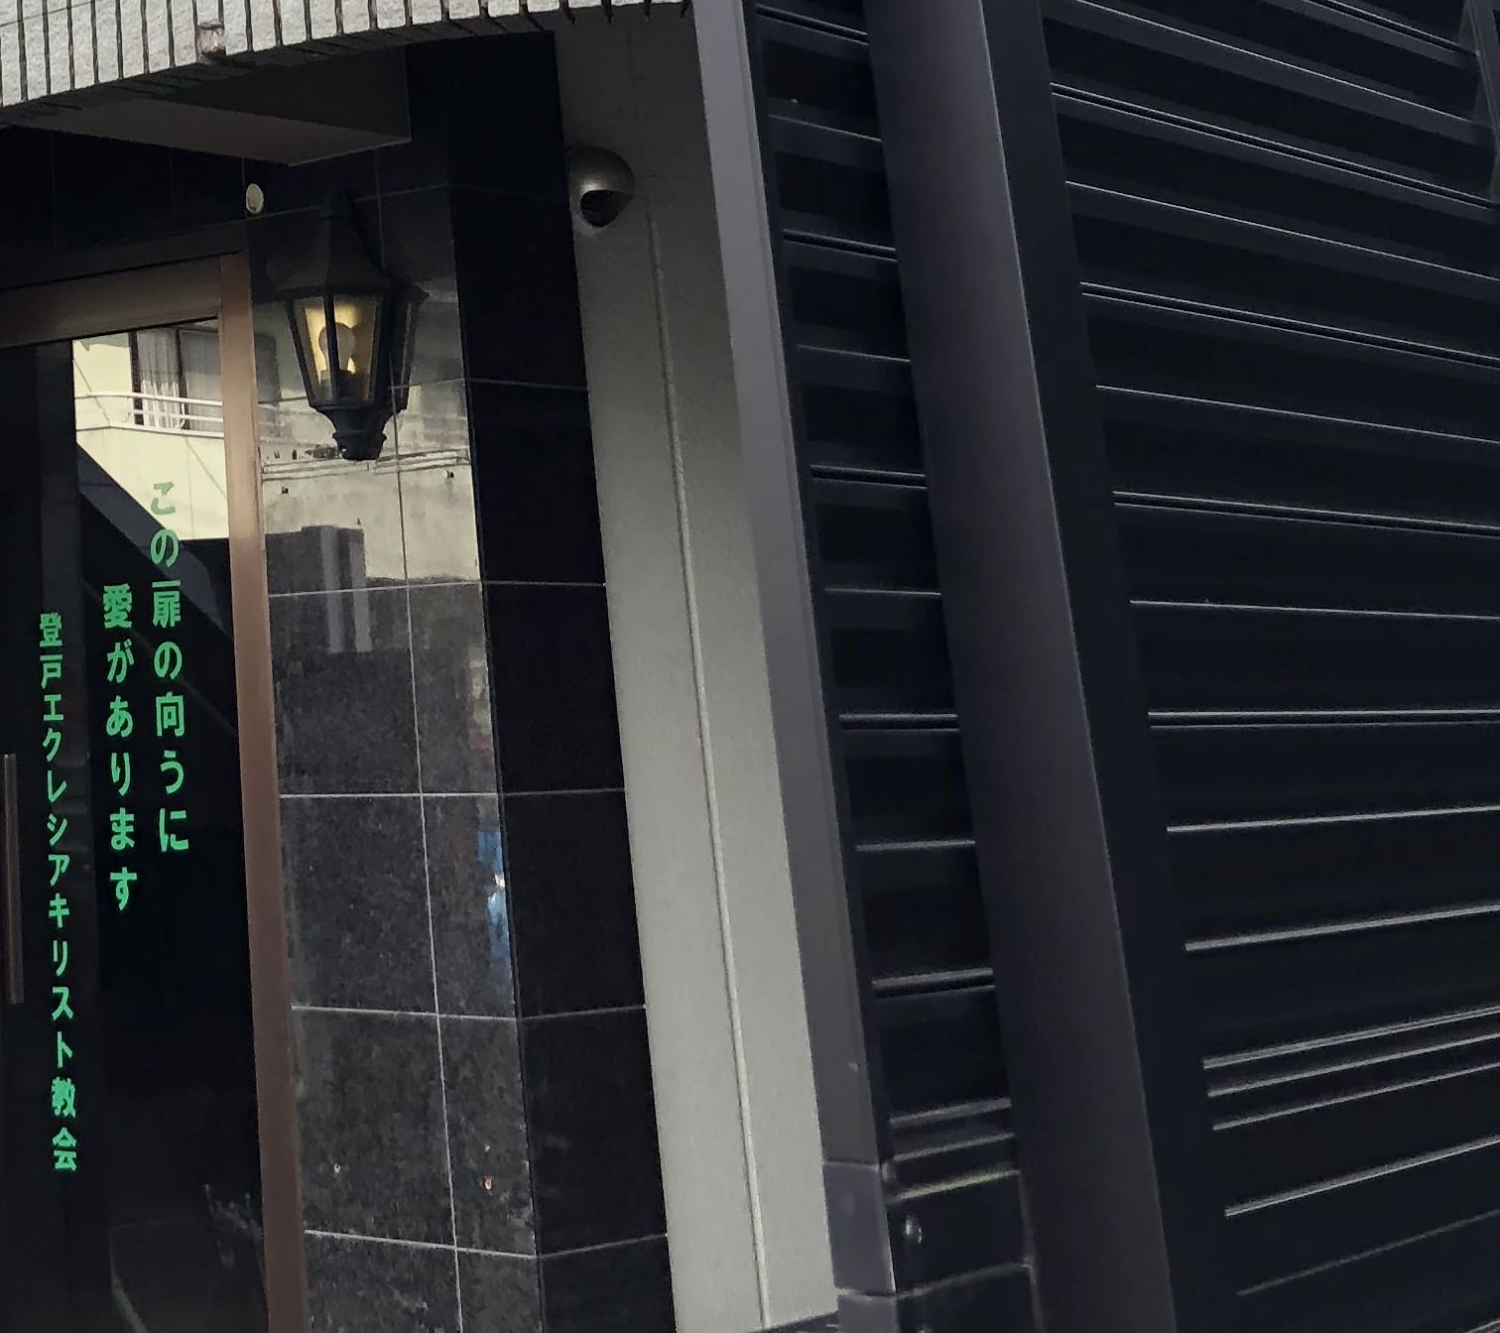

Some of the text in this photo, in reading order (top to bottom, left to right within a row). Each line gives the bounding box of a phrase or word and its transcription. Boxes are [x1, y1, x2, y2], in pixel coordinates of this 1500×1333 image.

[102, 582, 138, 912] 愛があります
[148, 480, 190, 853] この扉の向うに
[38, 611, 78, 1173] 登戸エクレシアキリスト教会
